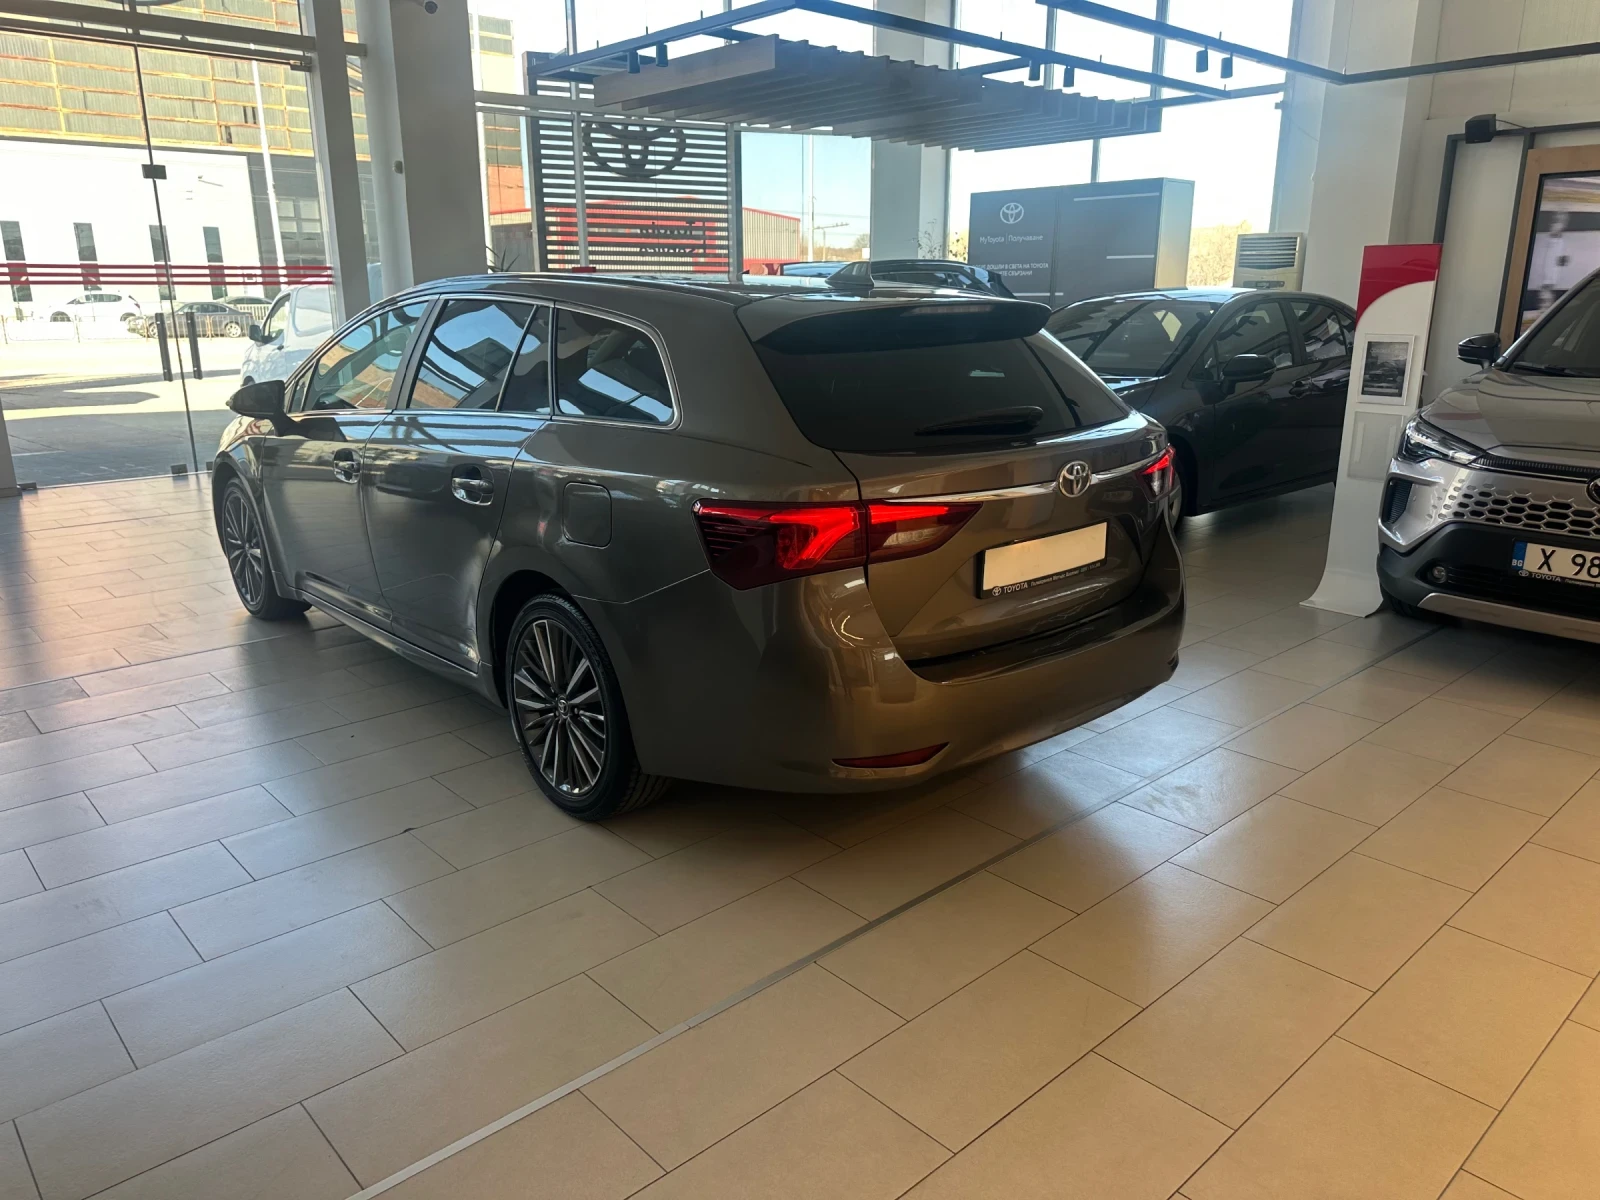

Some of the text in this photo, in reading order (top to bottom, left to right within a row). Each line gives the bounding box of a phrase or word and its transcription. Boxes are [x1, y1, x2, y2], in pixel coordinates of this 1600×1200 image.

[1511, 559, 1524, 567] BG
[1537, 548, 1556, 572] X
[1531, 572, 1561, 582] TOYOTA
[1003, 582, 1028, 593] TOYOTA
